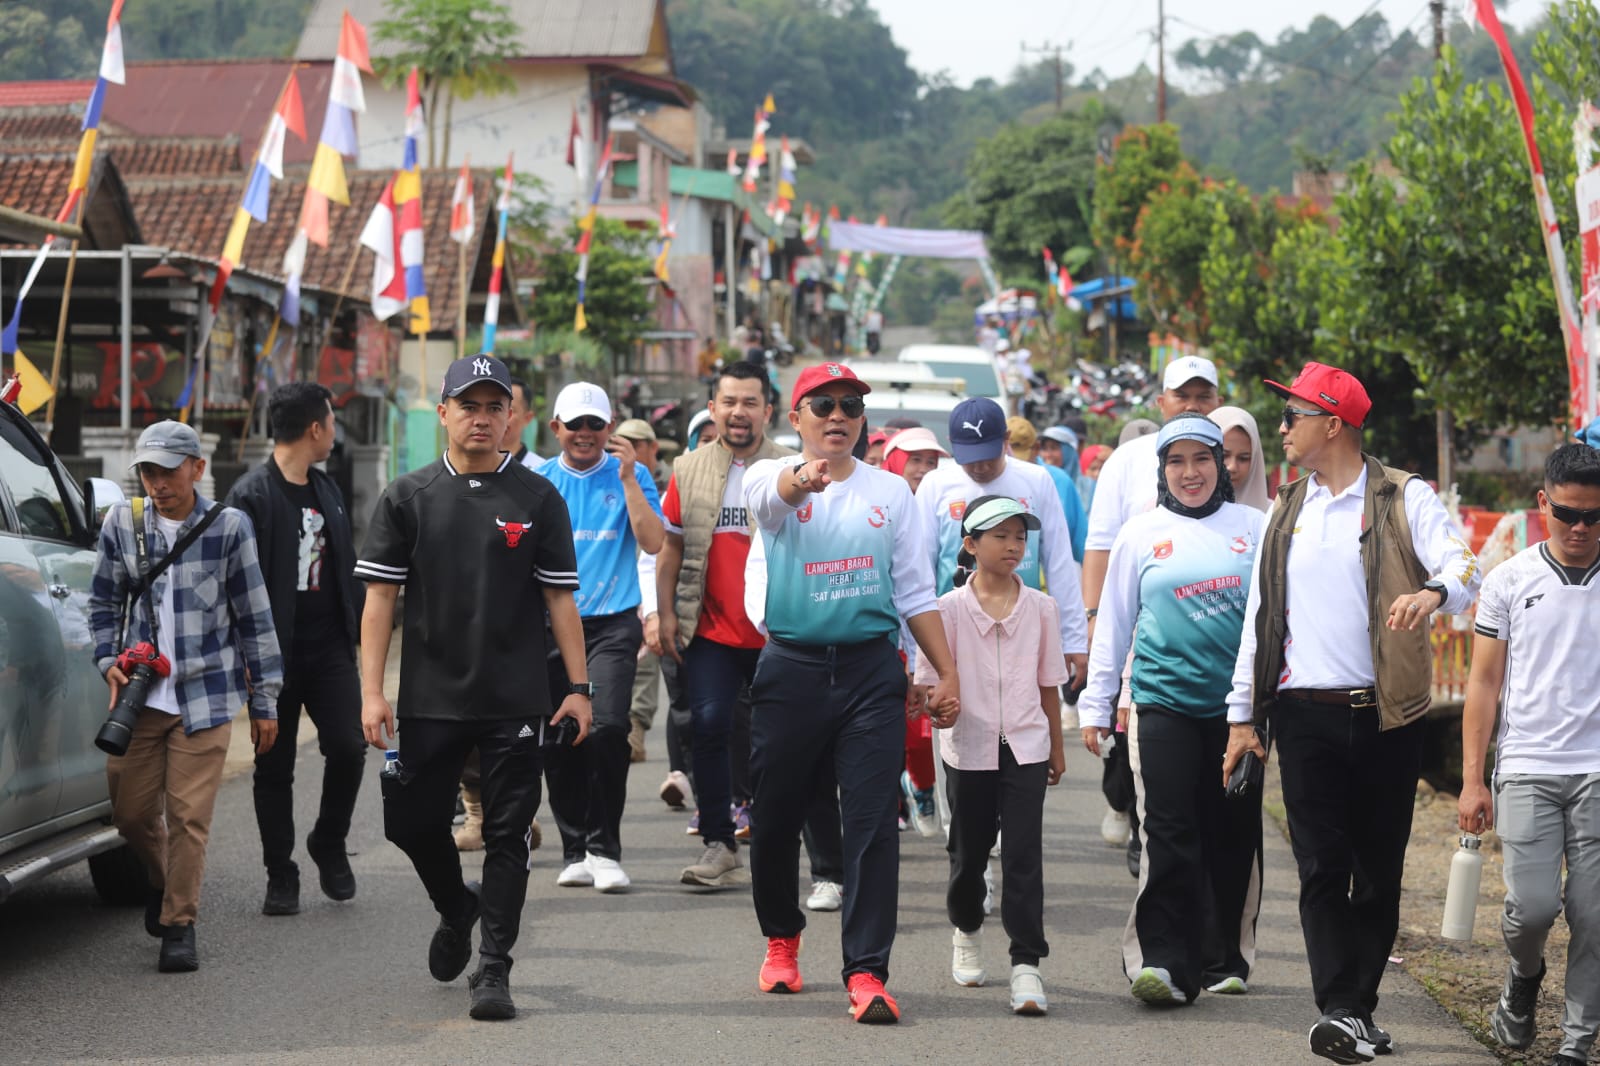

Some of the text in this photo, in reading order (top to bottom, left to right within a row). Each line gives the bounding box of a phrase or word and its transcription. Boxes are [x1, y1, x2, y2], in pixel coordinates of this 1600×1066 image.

[471, 357, 492, 377] NY
[806, 556, 872, 575] LAMPUNG BARAT
[829, 573, 854, 586] HEBAT
[1175, 576, 1241, 600] LAMPUNG BARAT
[830, 587, 860, 601] ANANDA
[1200, 591, 1224, 606] HEBAT
